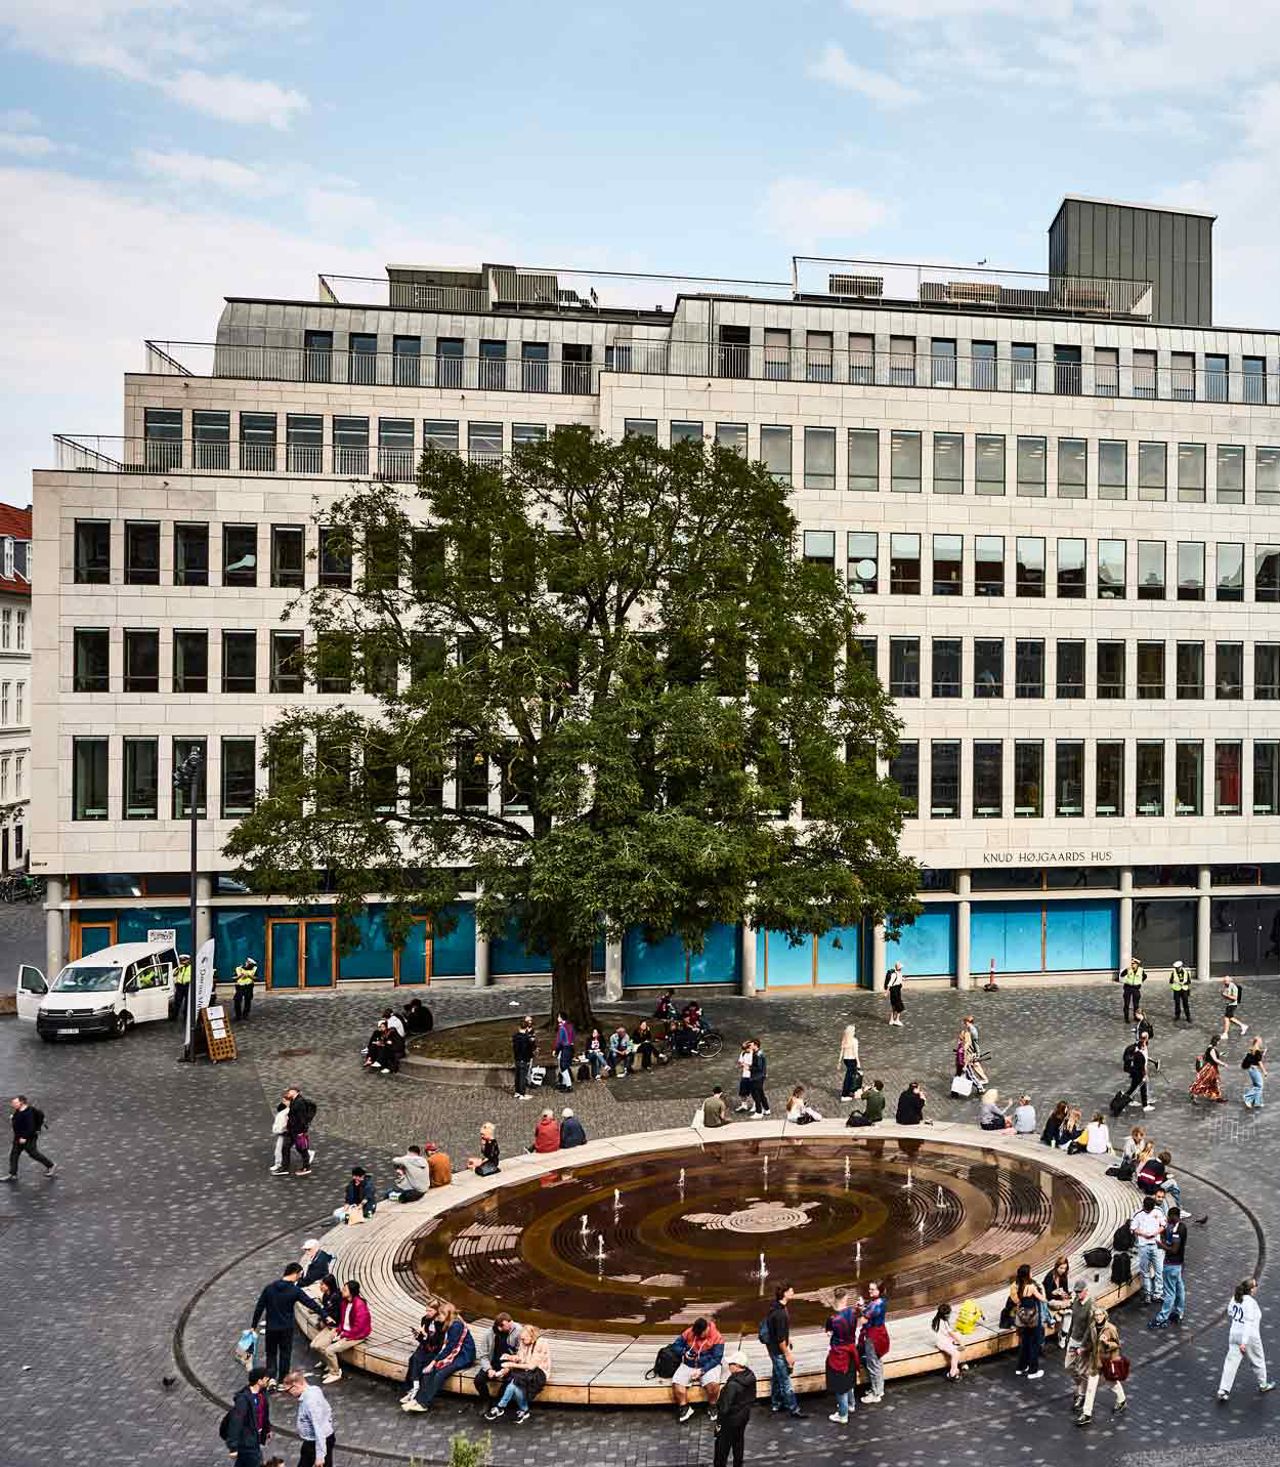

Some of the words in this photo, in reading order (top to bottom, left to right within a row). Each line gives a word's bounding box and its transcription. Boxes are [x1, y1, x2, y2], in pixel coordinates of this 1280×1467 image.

[983, 852, 1013, 863] KNUD
[1019, 851, 1085, 863] HØJGAARDS
[1091, 851, 1112, 861] HUS
[1232, 1304, 1245, 1325] 22
